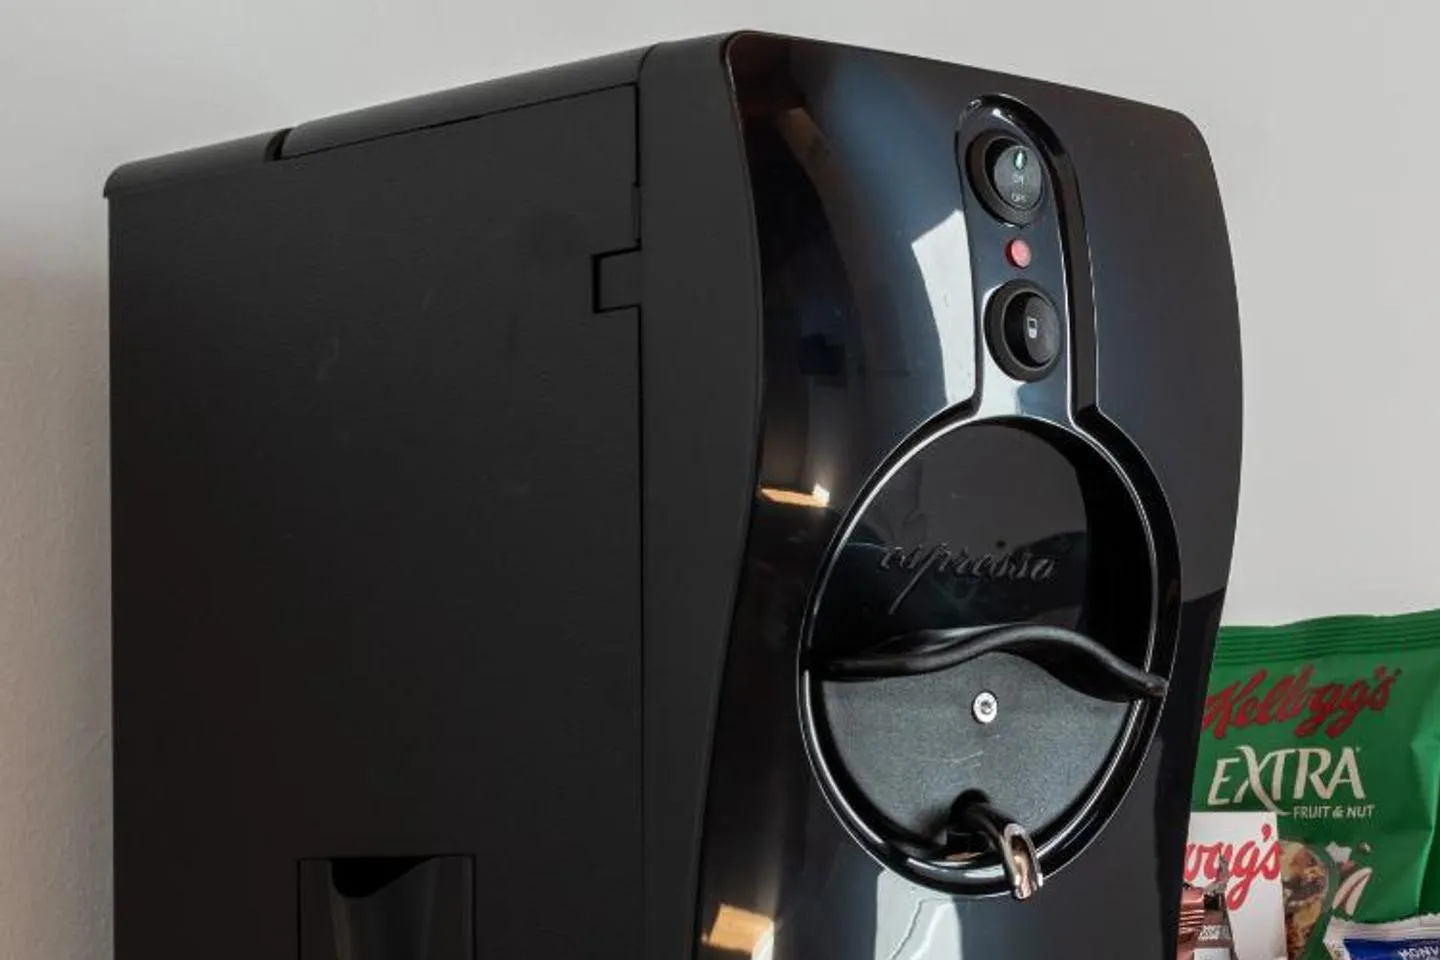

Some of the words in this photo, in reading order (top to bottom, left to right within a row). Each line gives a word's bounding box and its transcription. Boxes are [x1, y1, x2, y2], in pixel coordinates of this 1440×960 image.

[1202, 664, 1397, 740] Kellogg's
[1207, 745, 1366, 816] EXTRA
[1293, 804, 1332, 820] FRUIT
[1332, 805, 1344, 819] &
[1346, 804, 1375, 820] NUT
